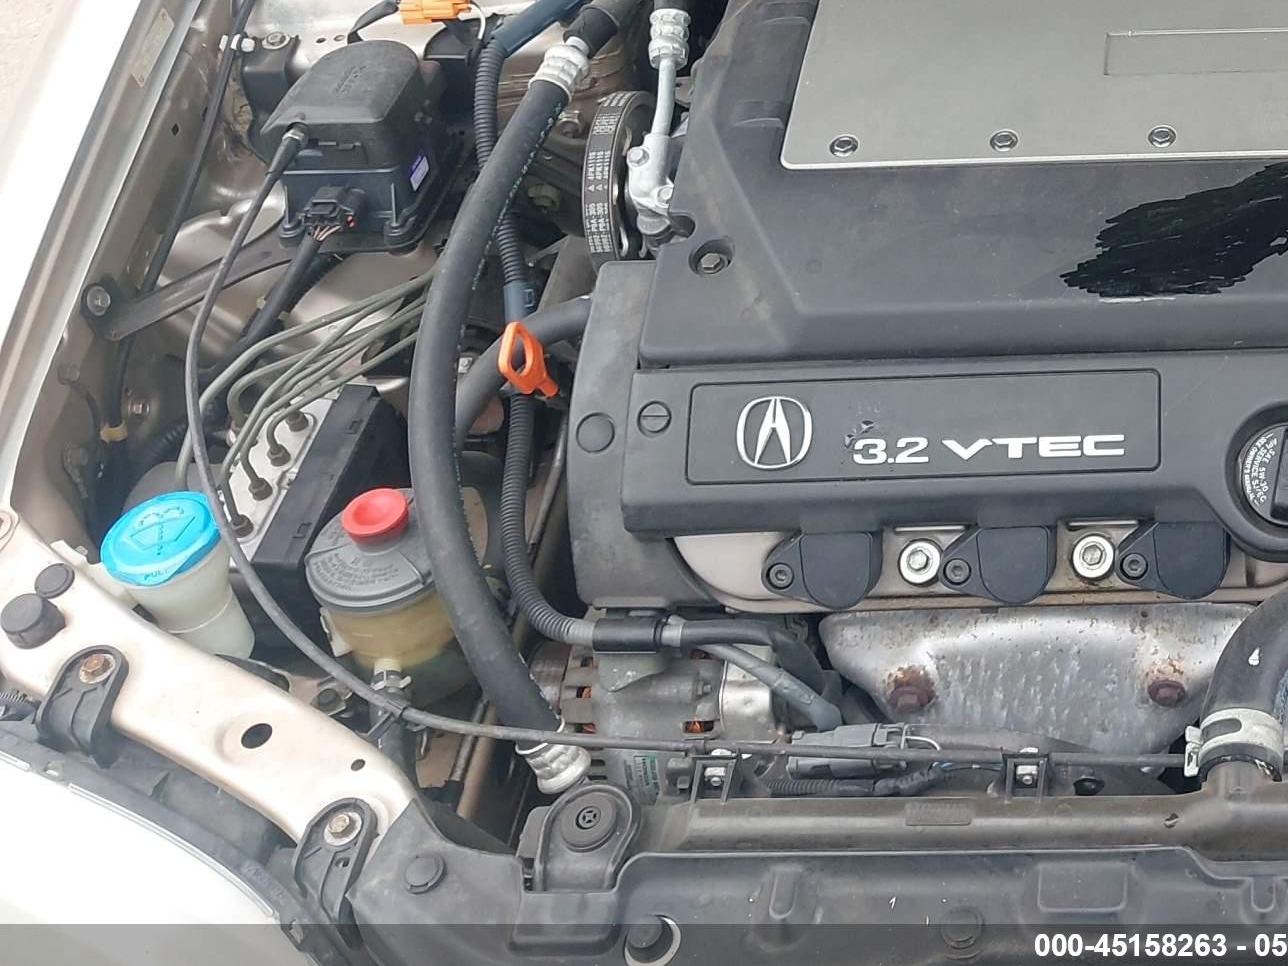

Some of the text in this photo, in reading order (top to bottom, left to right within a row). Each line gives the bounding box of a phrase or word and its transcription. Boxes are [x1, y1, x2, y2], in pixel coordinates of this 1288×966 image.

[853, 434, 1126, 465] 3.2 VTEC
[1265, 437, 1278, 449] API
[1251, 447, 1268, 477] SERVICE
[1264, 448, 1276, 464] SAE
